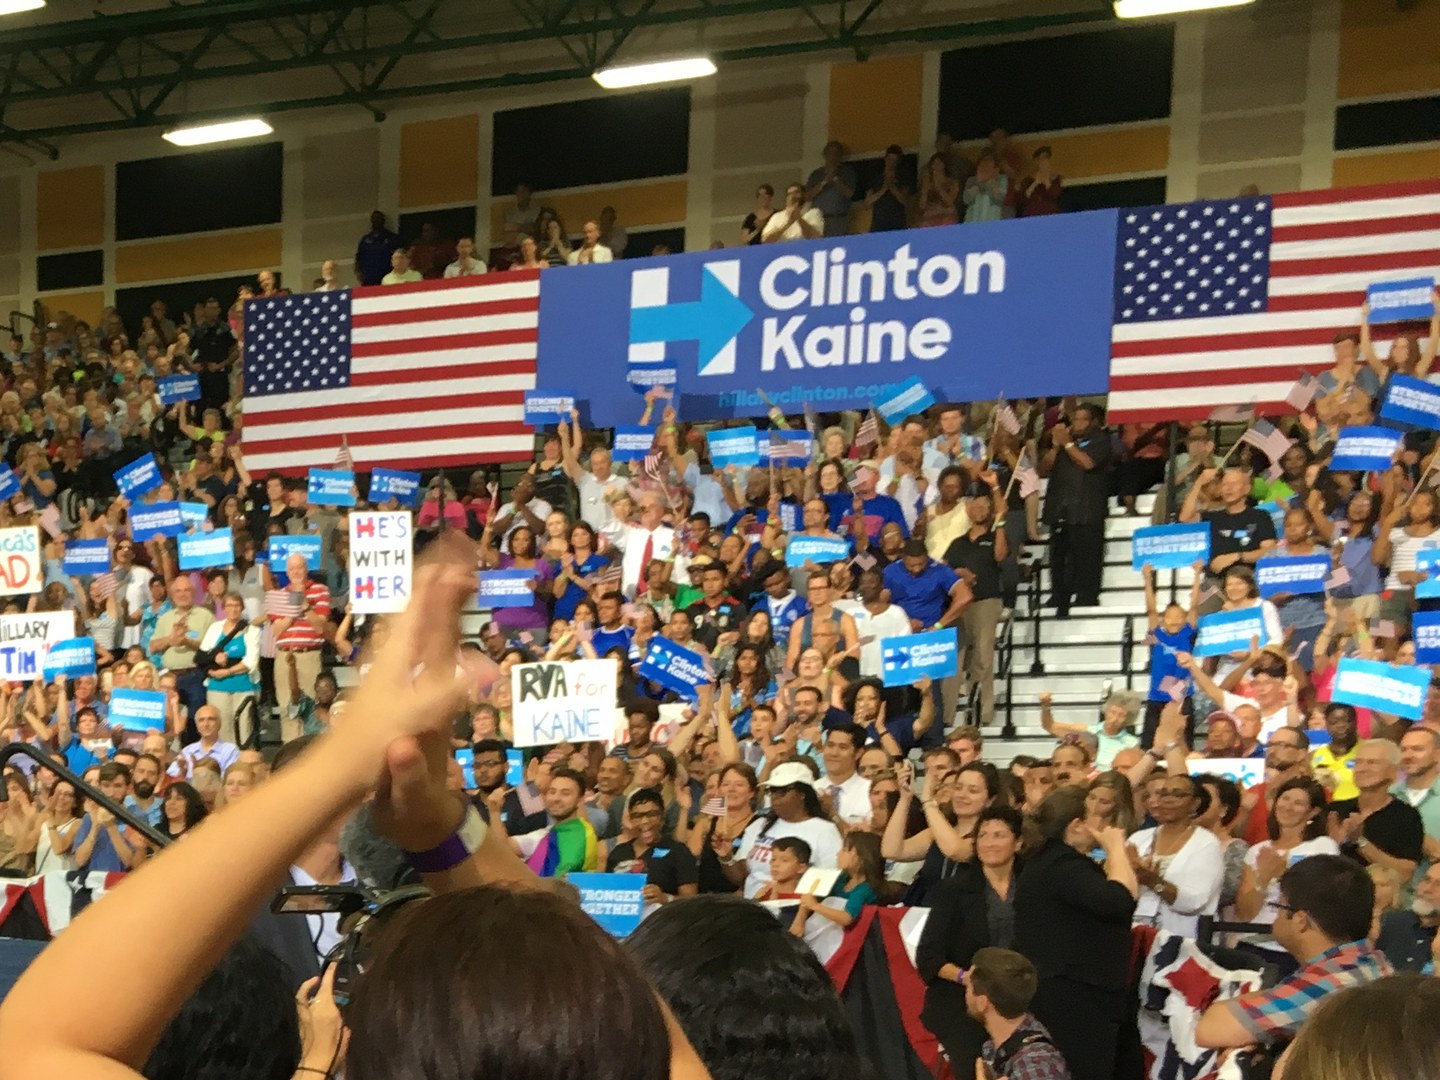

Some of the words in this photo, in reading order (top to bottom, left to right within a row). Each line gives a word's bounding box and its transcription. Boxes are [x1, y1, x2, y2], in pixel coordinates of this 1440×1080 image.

[760, 243, 1006, 310] Clinton
[761, 307, 952, 371] Kaine
[356, 515, 407, 539] HE'S
[353, 549, 406, 568] WITH
[355, 575, 407, 599] HER
[520, 664, 567, 703] RVA
[574, 673, 607, 695] for
[533, 708, 600, 743] KAINE
